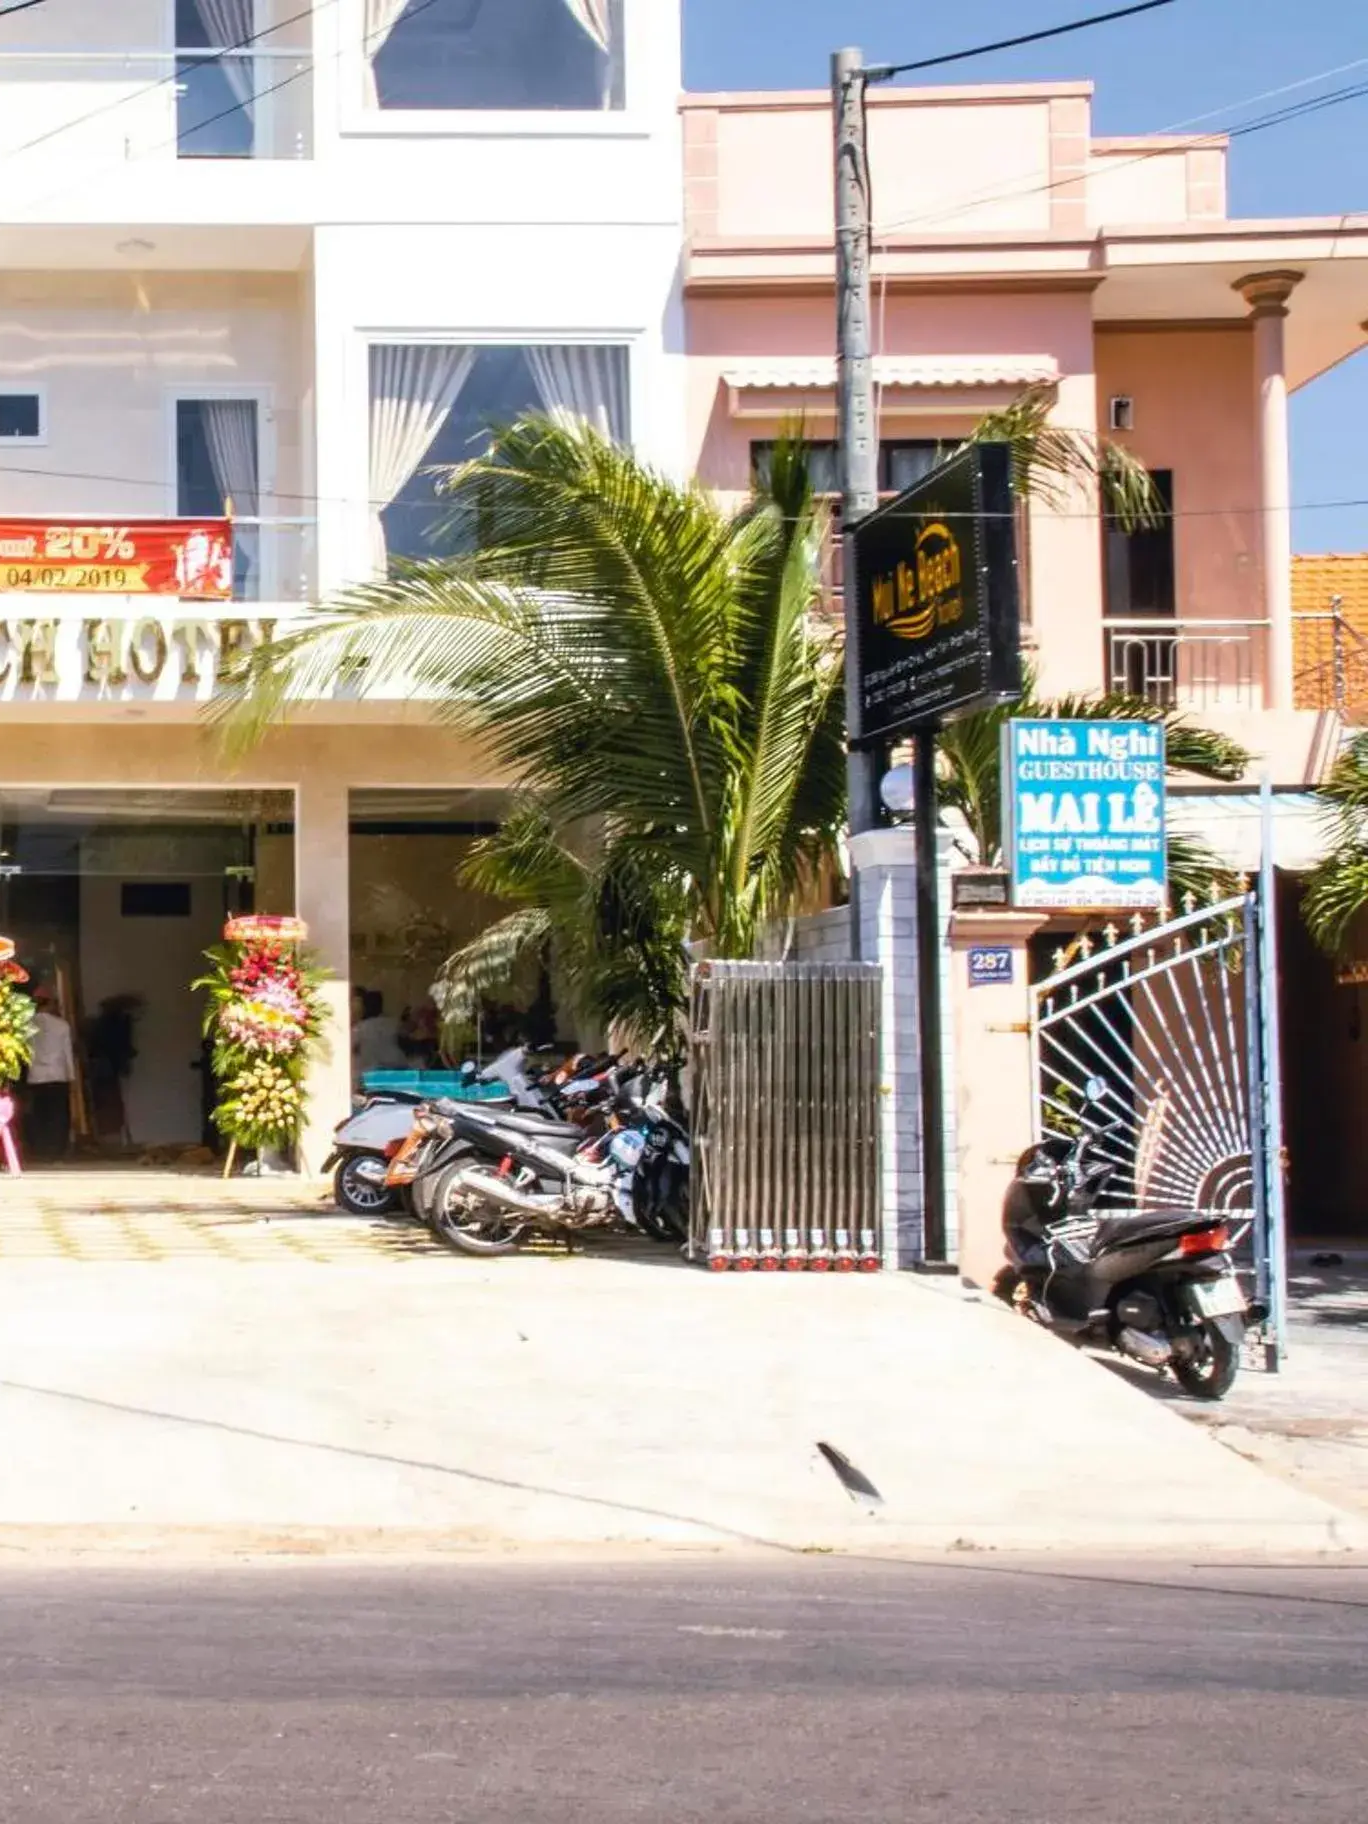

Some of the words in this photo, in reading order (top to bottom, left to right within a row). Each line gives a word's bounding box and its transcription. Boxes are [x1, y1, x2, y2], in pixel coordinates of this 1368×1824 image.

[45, 526, 135, 559] 20%
[6, 567, 127, 588] 04/02/2019
[1019, 728, 1077, 756] Nhà
[1088, 726, 1159, 760] Nghỉ
[1019, 760, 1159, 781] GUESTHOUSE
[1019, 792, 1100, 833] MAI
[973, 952, 1009, 969] 287
